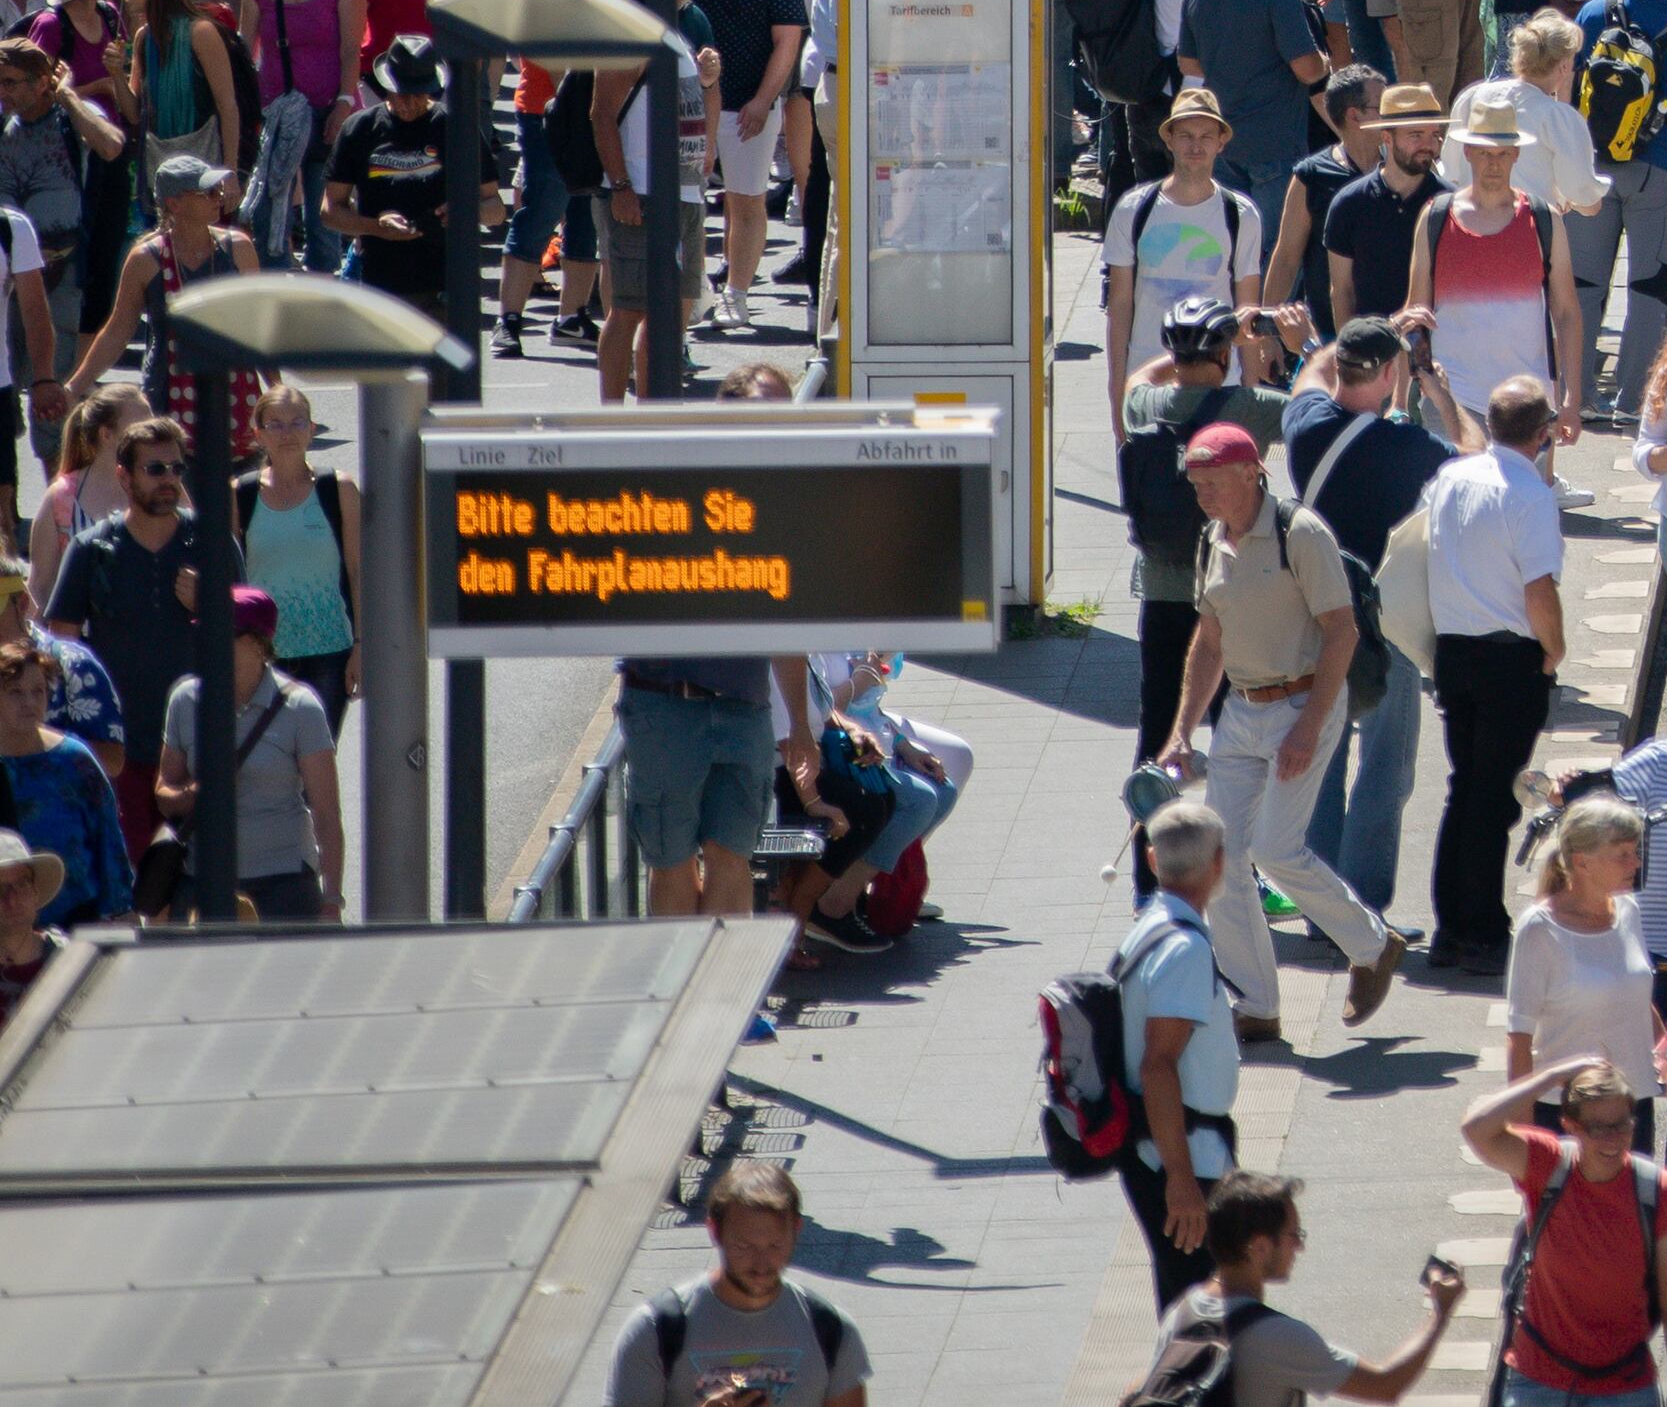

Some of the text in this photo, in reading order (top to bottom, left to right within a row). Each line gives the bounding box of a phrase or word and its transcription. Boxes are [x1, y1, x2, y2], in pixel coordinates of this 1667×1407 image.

[890, 5, 951, 16] Tarifbereich
[458, 441, 957, 466] Linie Ziel Abfahrt in
[456, 487, 757, 537] Bitte beachten Sie
[457, 546, 791, 603] den Fahrplanaushang
